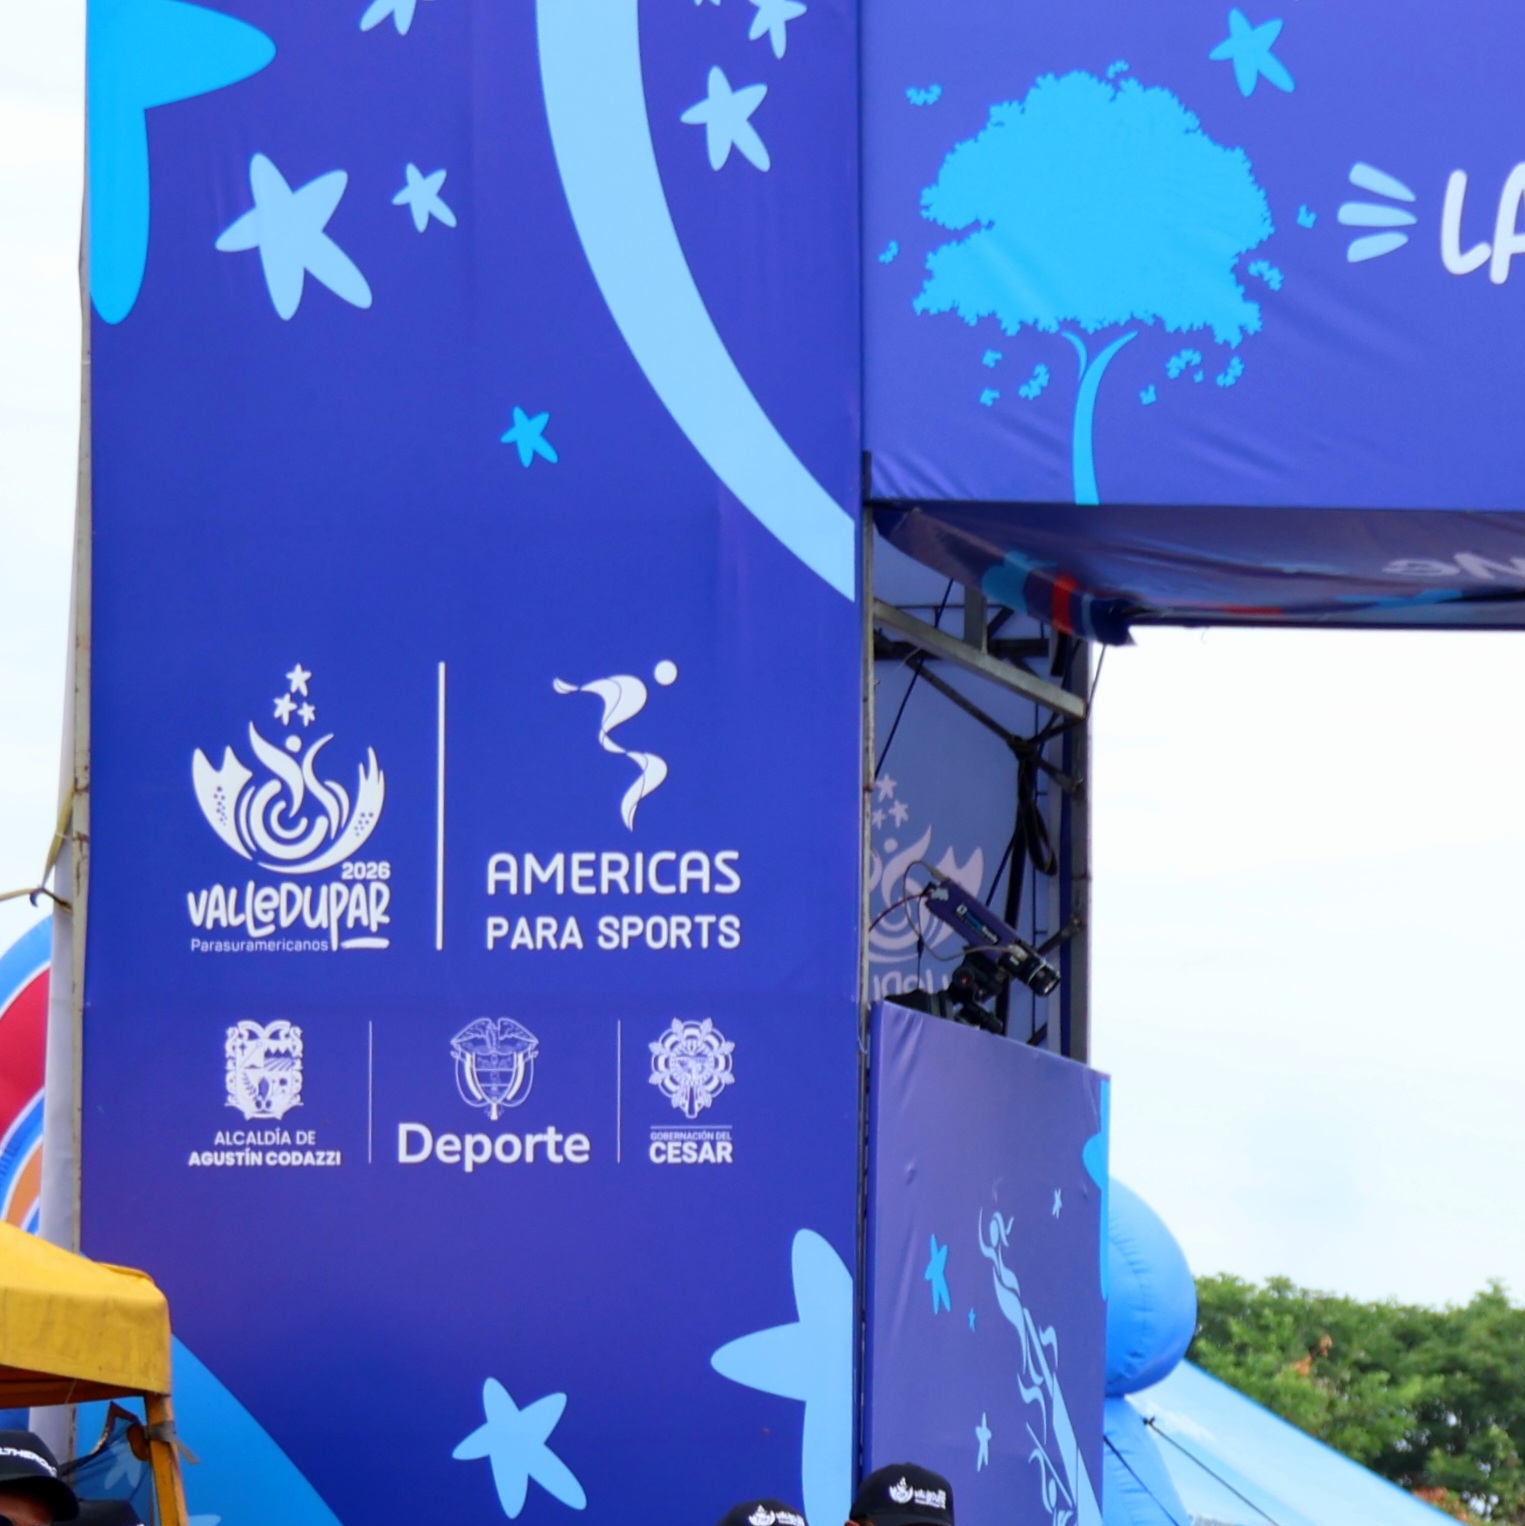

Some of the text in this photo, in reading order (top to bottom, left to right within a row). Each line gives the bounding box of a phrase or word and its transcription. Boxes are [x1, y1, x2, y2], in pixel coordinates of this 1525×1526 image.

[341, 861, 390, 880] 2026
[487, 852, 741, 895] AMERICAS
[487, 914, 741, 950] PARA SPORTS
[191, 938, 328, 952] Parasuramericanos
[214, 1127, 316, 1145] ALCALDÍA DE
[716, 1131, 732, 1141] DEL
[188, 1148, 341, 1166] AGUSTÍN CODAZZI
[399, 1123, 589, 1173] Deporte
[649, 1141, 733, 1163] CESAR
